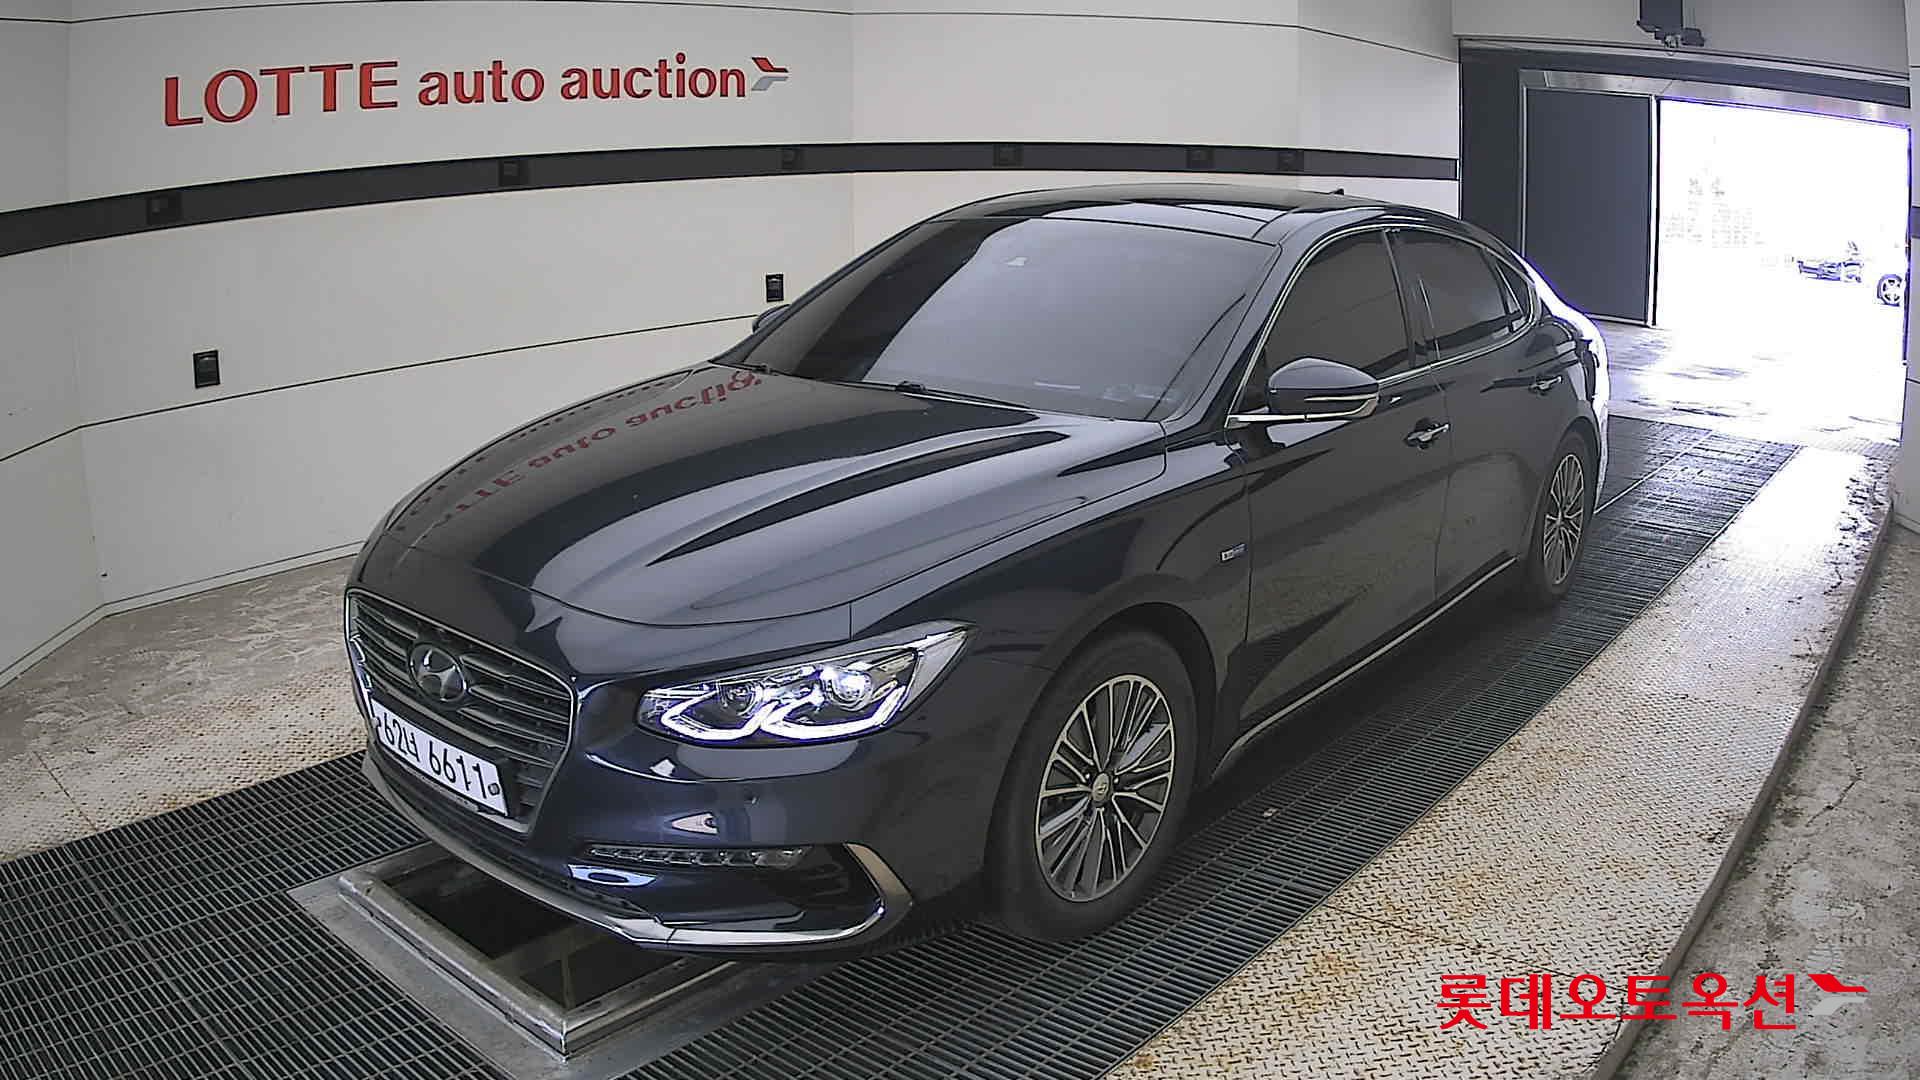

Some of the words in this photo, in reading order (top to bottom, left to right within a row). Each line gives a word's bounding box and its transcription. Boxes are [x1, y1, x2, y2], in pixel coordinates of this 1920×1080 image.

[164, 61, 399, 127] LOTTE
[418, 59, 545, 106] auto
[560, 52, 747, 101] auction
[383, 712, 421, 763] 62너
[428, 740, 487, 799] 6611
